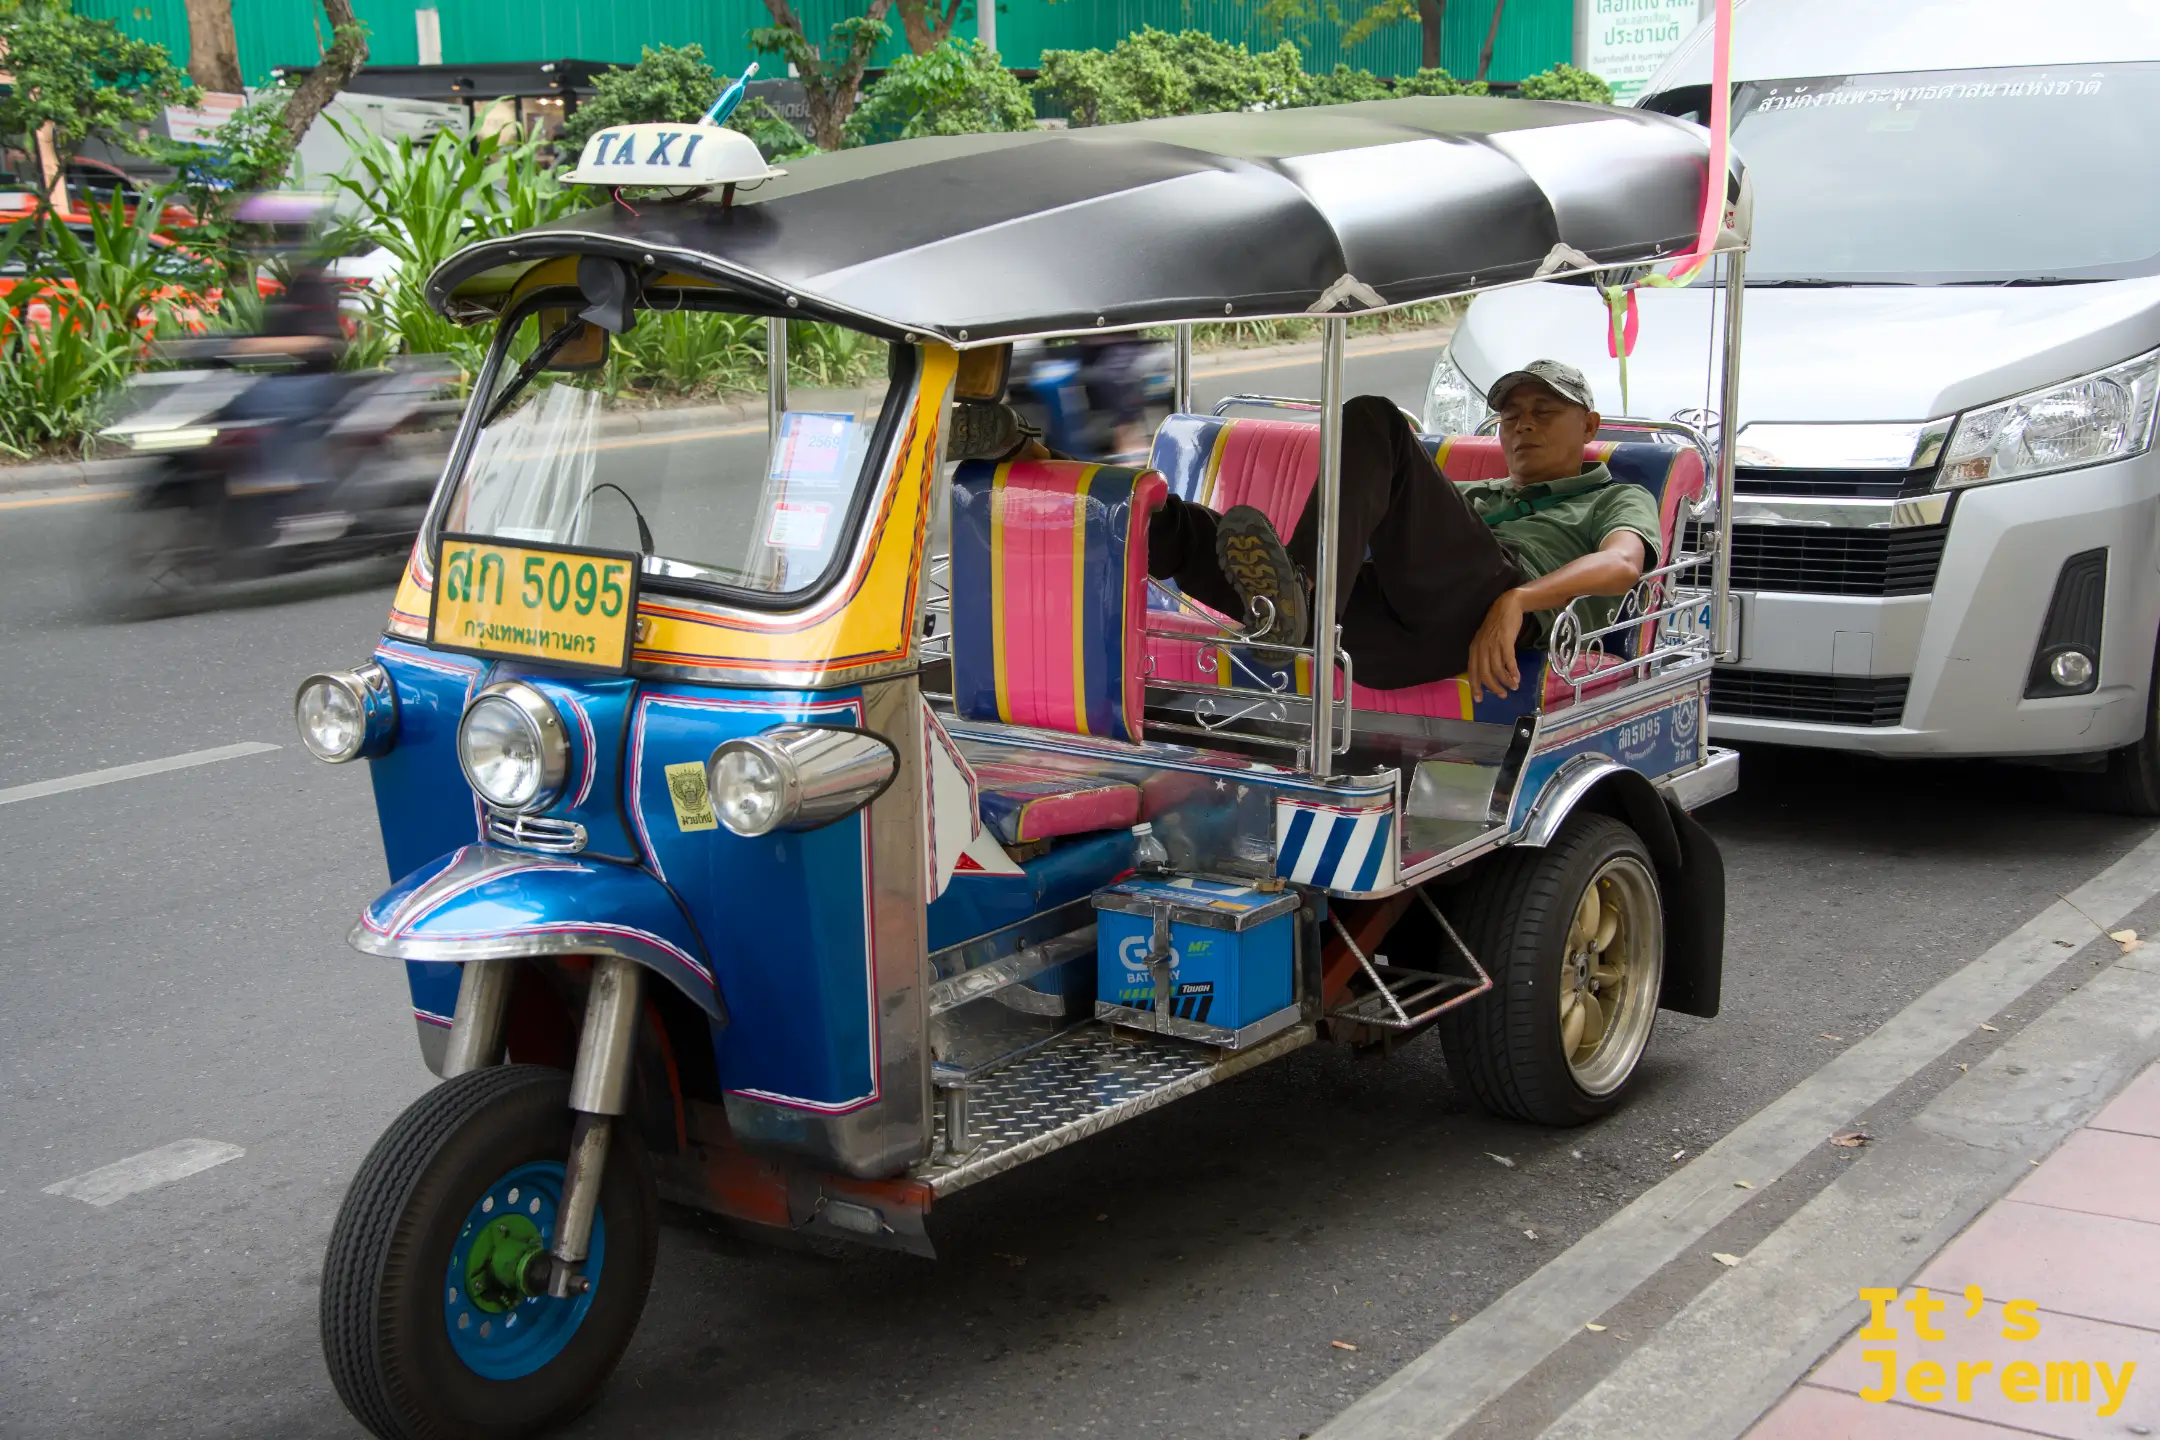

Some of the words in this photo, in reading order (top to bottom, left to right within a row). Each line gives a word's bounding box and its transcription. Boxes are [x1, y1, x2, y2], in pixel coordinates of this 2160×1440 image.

[1604, 21, 1679, 46] ประชามติ
[1757, 72, 2105, 113] สำนักงานพระพุทธศาสนาแห่งชาติ
[593, 132, 704, 168] TAXI
[808, 435, 841, 449] 2569
[447, 548, 505, 605] สก
[521, 556, 625, 618] 5095
[464, 618, 596, 654] กรุงเทพมหานคร
[1187, 940, 1213, 953] MF
